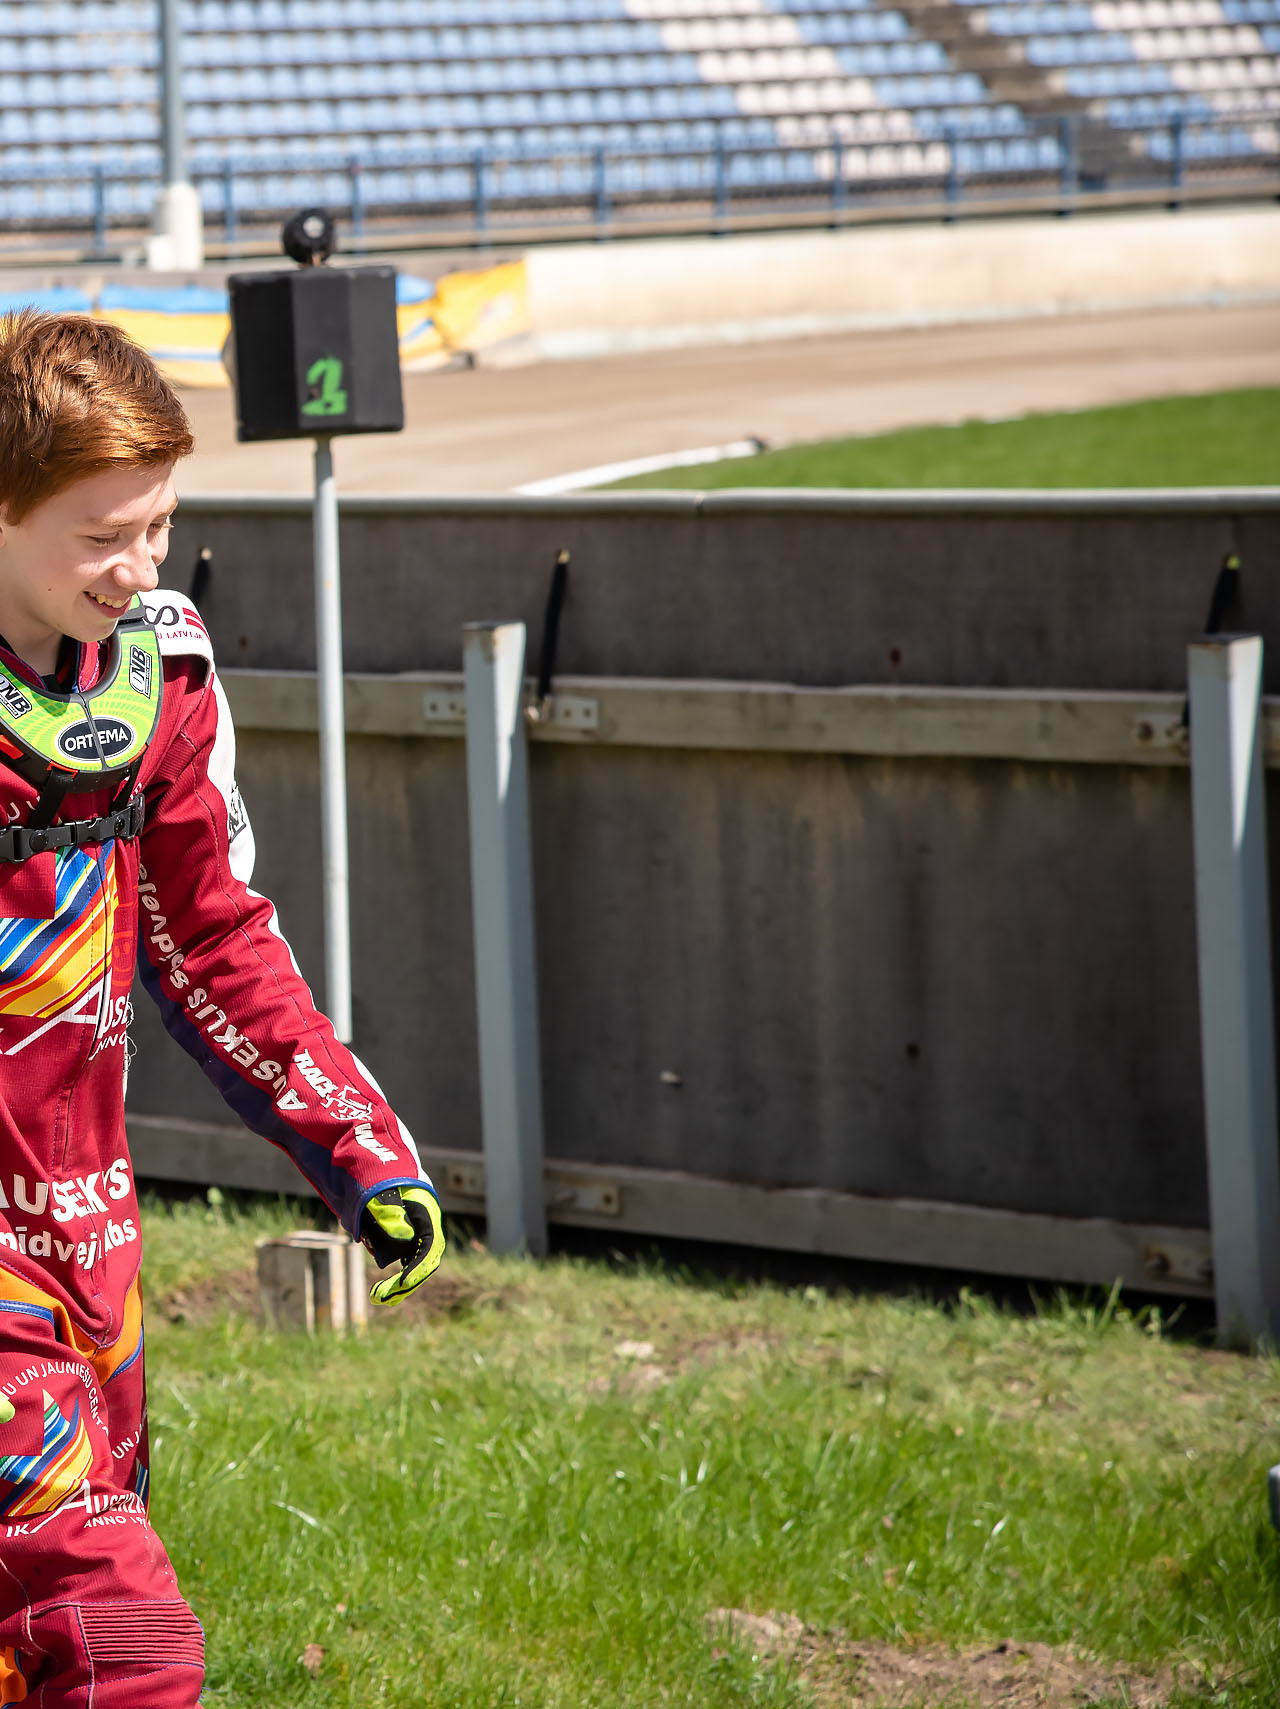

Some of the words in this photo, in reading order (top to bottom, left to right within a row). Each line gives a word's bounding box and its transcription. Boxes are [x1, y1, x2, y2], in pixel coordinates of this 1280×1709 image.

[64, 726, 129, 752] ORTEMA
[15, 1365, 39, 1386] UN
[111, 1436, 135, 1460] UN
[5, 1523, 30, 1539] IK
[83, 1515, 127, 1529] ANNO
